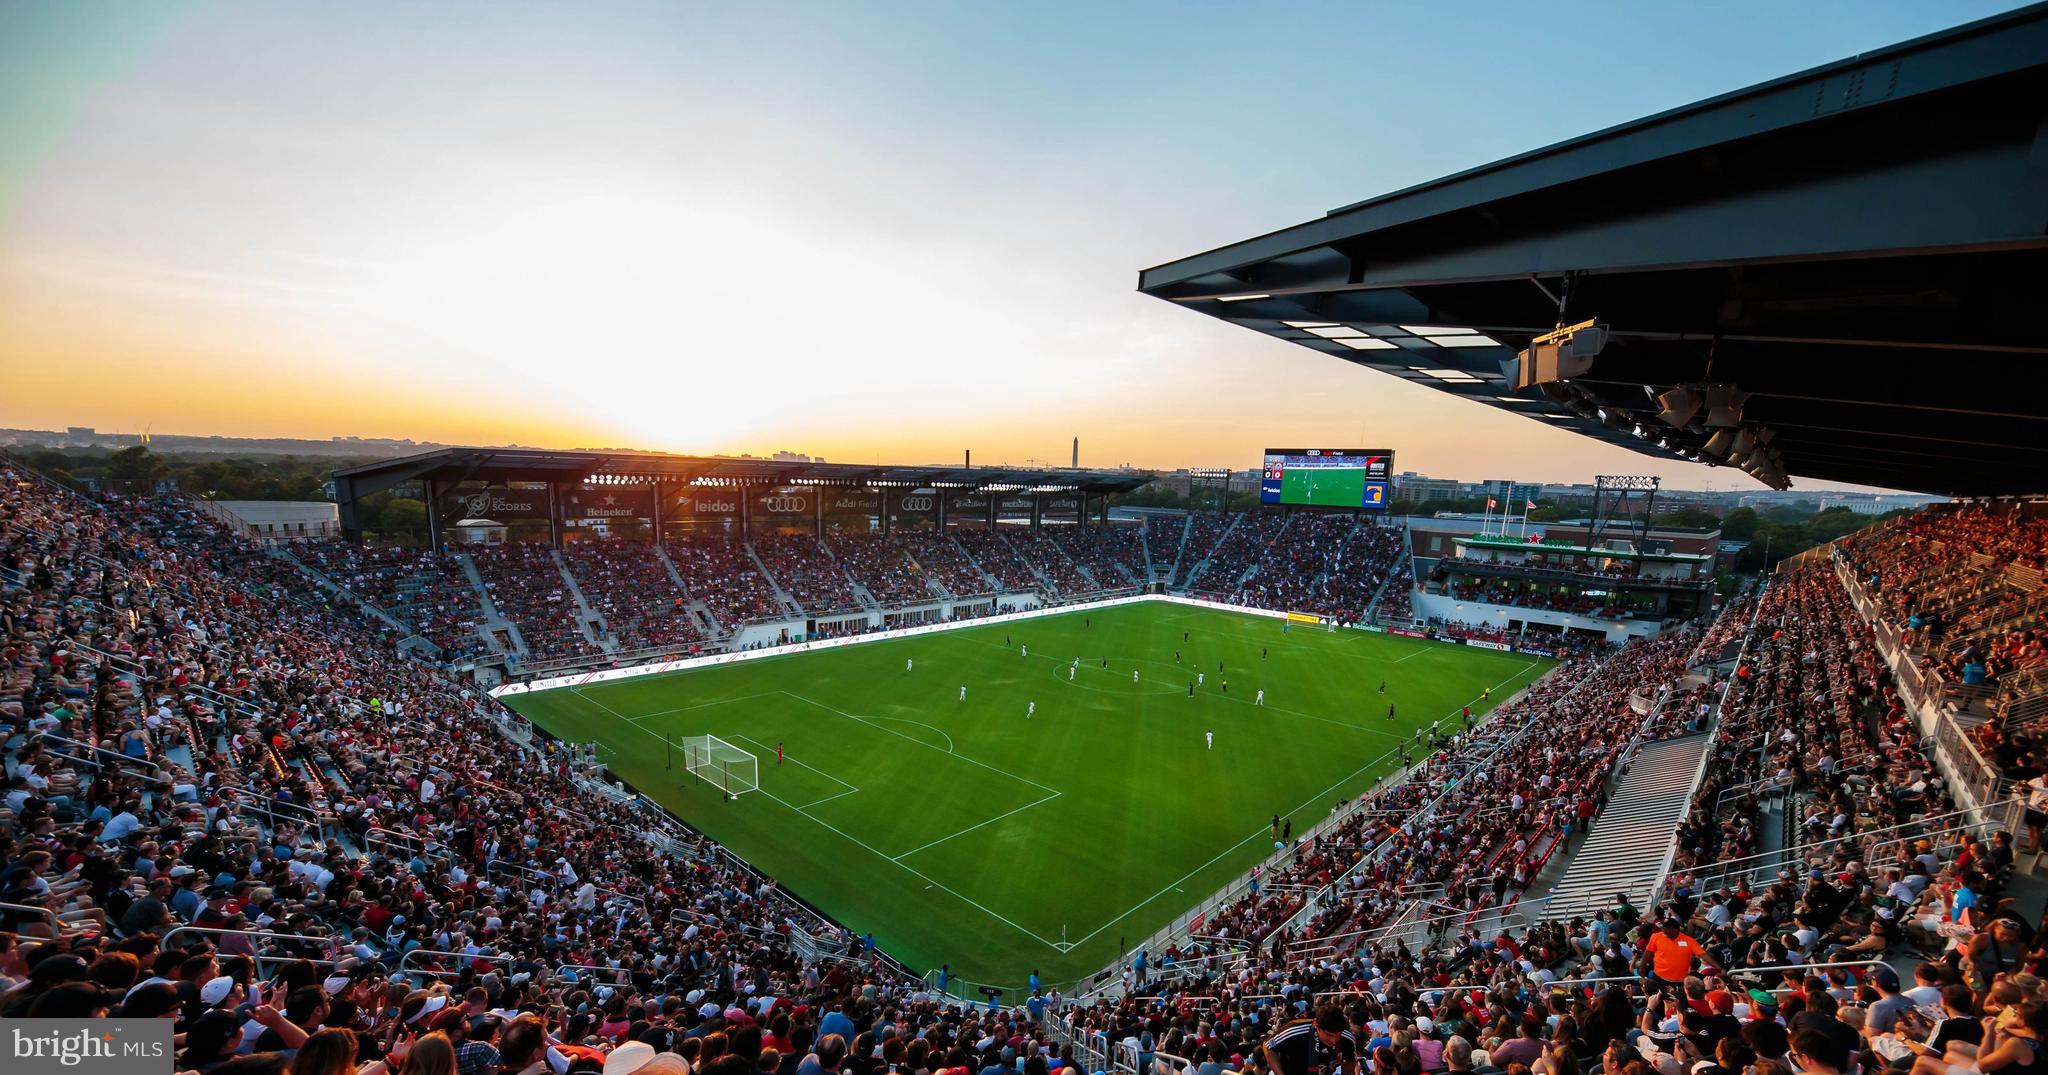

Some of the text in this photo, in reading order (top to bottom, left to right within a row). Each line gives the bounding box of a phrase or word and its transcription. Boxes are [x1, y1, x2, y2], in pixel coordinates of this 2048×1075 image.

[492, 503, 532, 511] SCORES
[695, 499, 736, 512] leidos
[835, 500, 878, 508] Audi Field
[587, 508, 633, 517] Heineken
[1352, 623, 1382, 632] Heineken
[1471, 640, 1497, 649] SAFEWAY
[1520, 648, 1552, 657] EAGLEBANK
